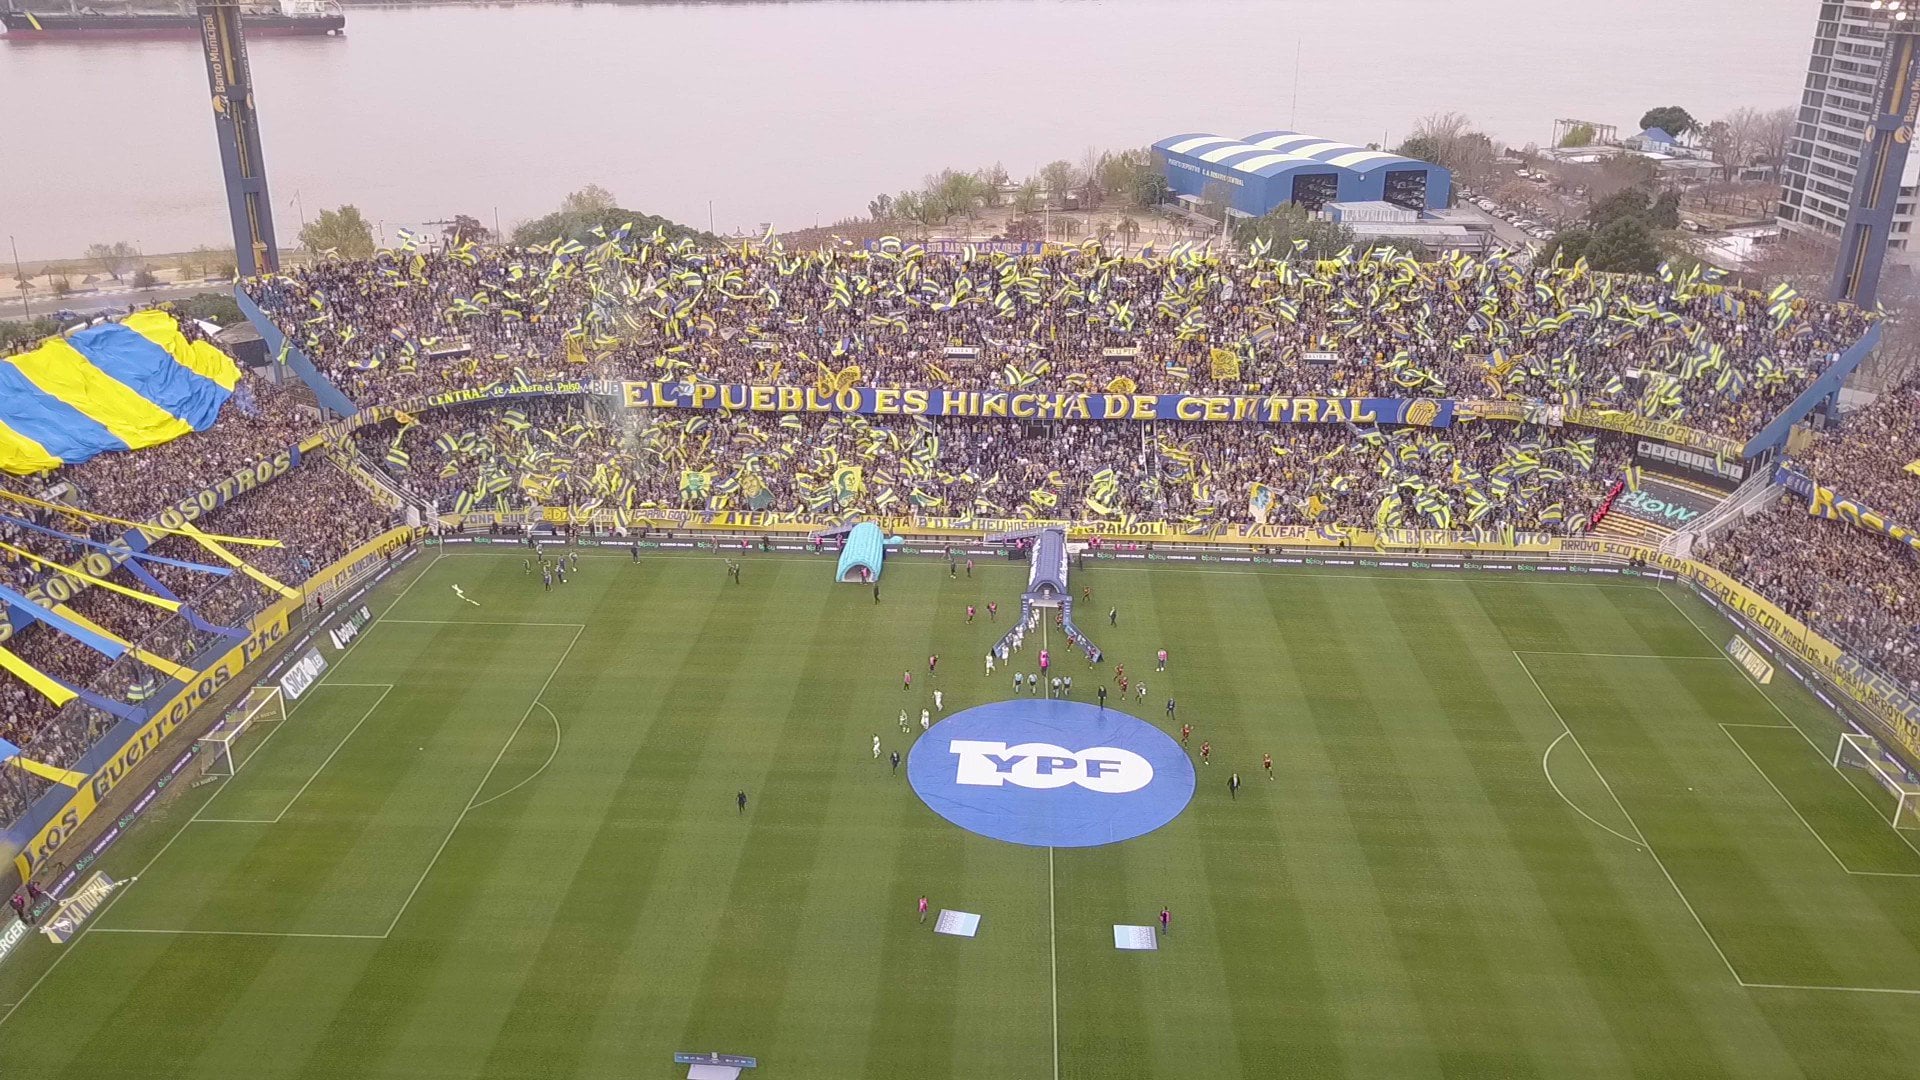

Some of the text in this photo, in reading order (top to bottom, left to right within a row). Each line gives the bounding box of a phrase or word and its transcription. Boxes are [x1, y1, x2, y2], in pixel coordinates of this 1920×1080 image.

[622, 382, 1377, 423] EL PUEBLO ES HINCHA DE CENTRAL
[26, 538, 133, 610] SOMOS
[138, 451, 290, 544] NOSOTROS
[578, 538, 599, 547] bplay
[638, 540, 658, 549] bplay
[1561, 540, 1600, 552] ARROYO
[1097, 551, 1115, 560] bplay
[1148, 552, 1166, 561] bplay
[1201, 554, 1220, 562] bplay
[1253, 556, 1272, 564] bplay
[1306, 557, 1324, 566] bplay
[1359, 559, 1378, 568] bplay
[1412, 561, 1430, 569] bplay
[1464, 562, 1482, 570] bplay
[1569, 565, 1588, 573] bplay
[1622, 568, 1641, 576] bplay
[983, 753, 1123, 779] YPF
[65, 902, 86, 926] LA
[0, 920, 27, 957] ERGER
